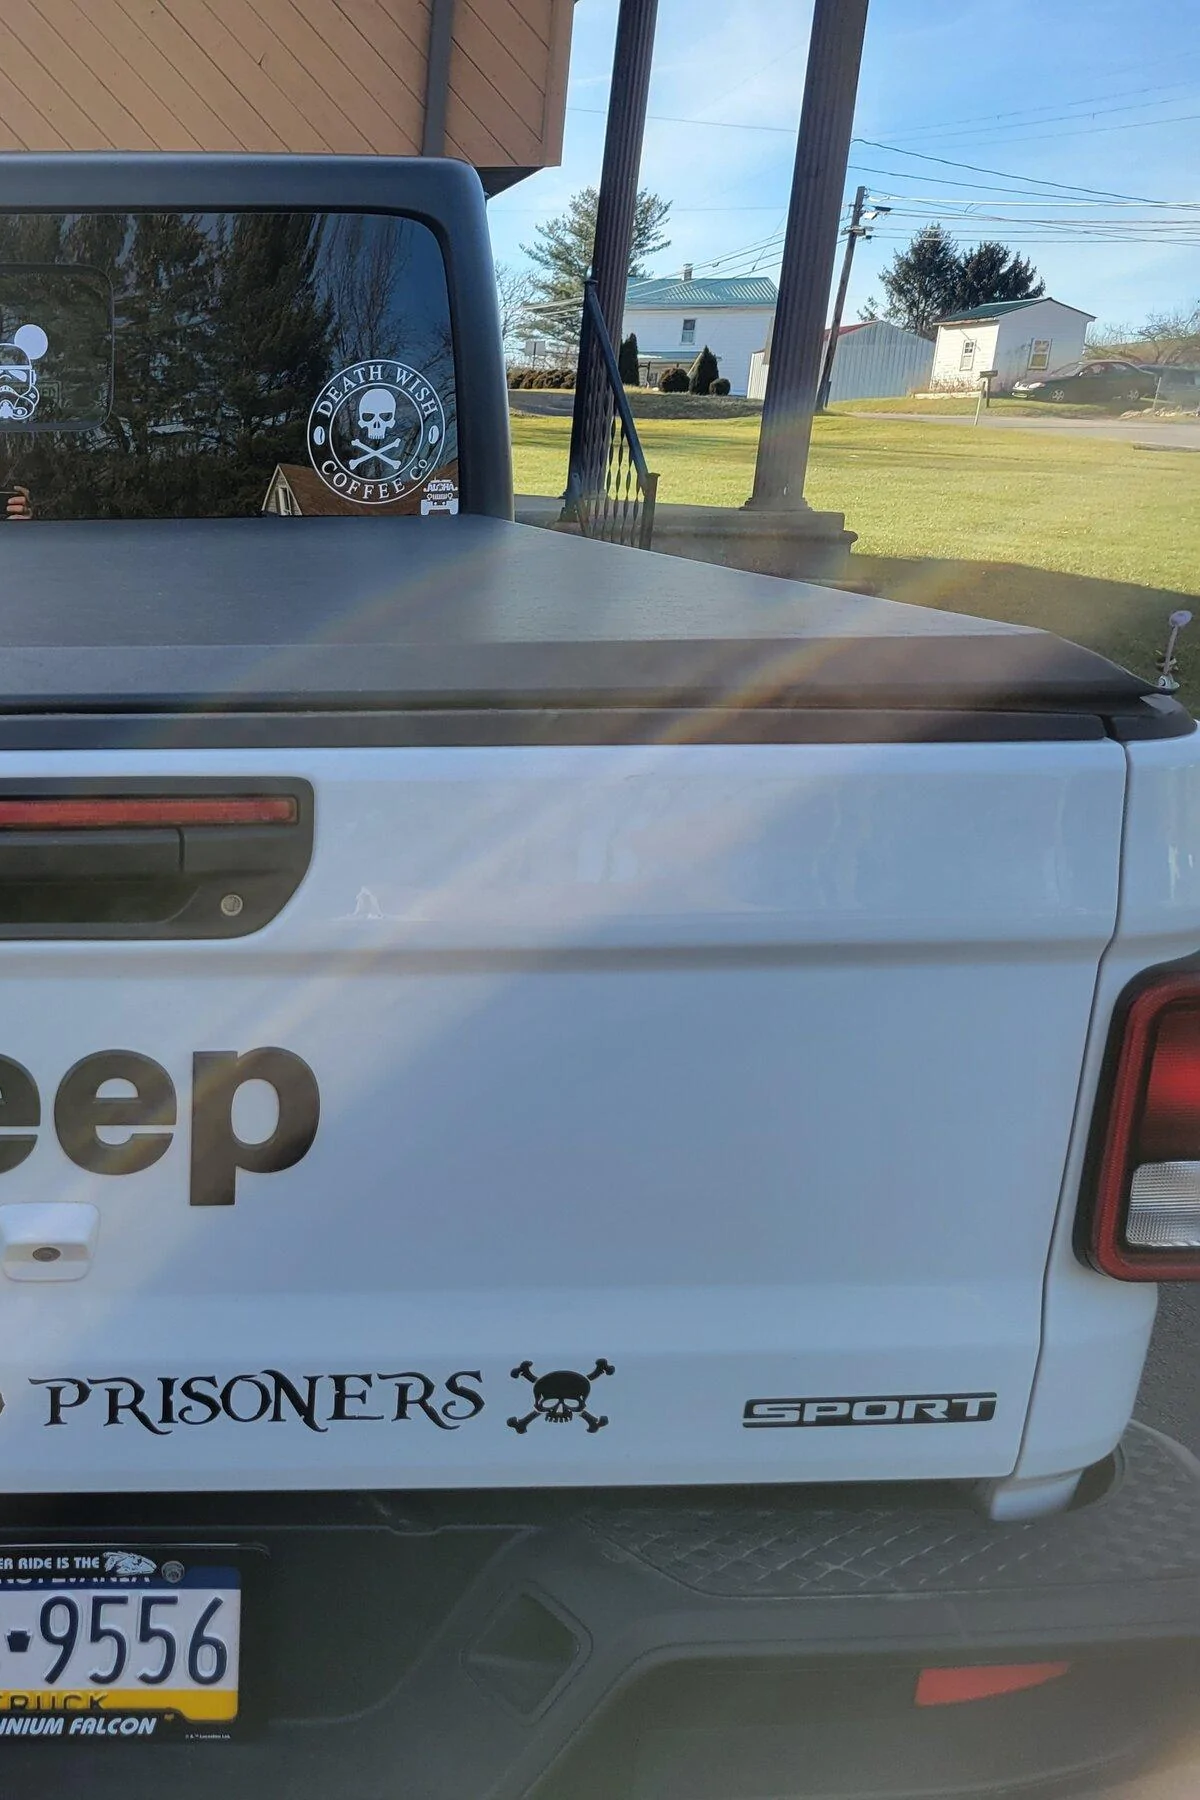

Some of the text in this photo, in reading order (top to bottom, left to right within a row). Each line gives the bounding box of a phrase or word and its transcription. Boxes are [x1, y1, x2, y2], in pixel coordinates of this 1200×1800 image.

[316, 364, 438, 418] DEATH WISH
[321, 459, 406, 500] COFFEE
[27, 1368, 486, 1436] PRISONERS
[743, 1395, 998, 1423] SPORT
[18, 1556, 53, 1570] RIDE
[57, 1556, 71, 1570] IS
[74, 1555, 101, 1570] THE
[69, 1716, 158, 1736] FALCON
